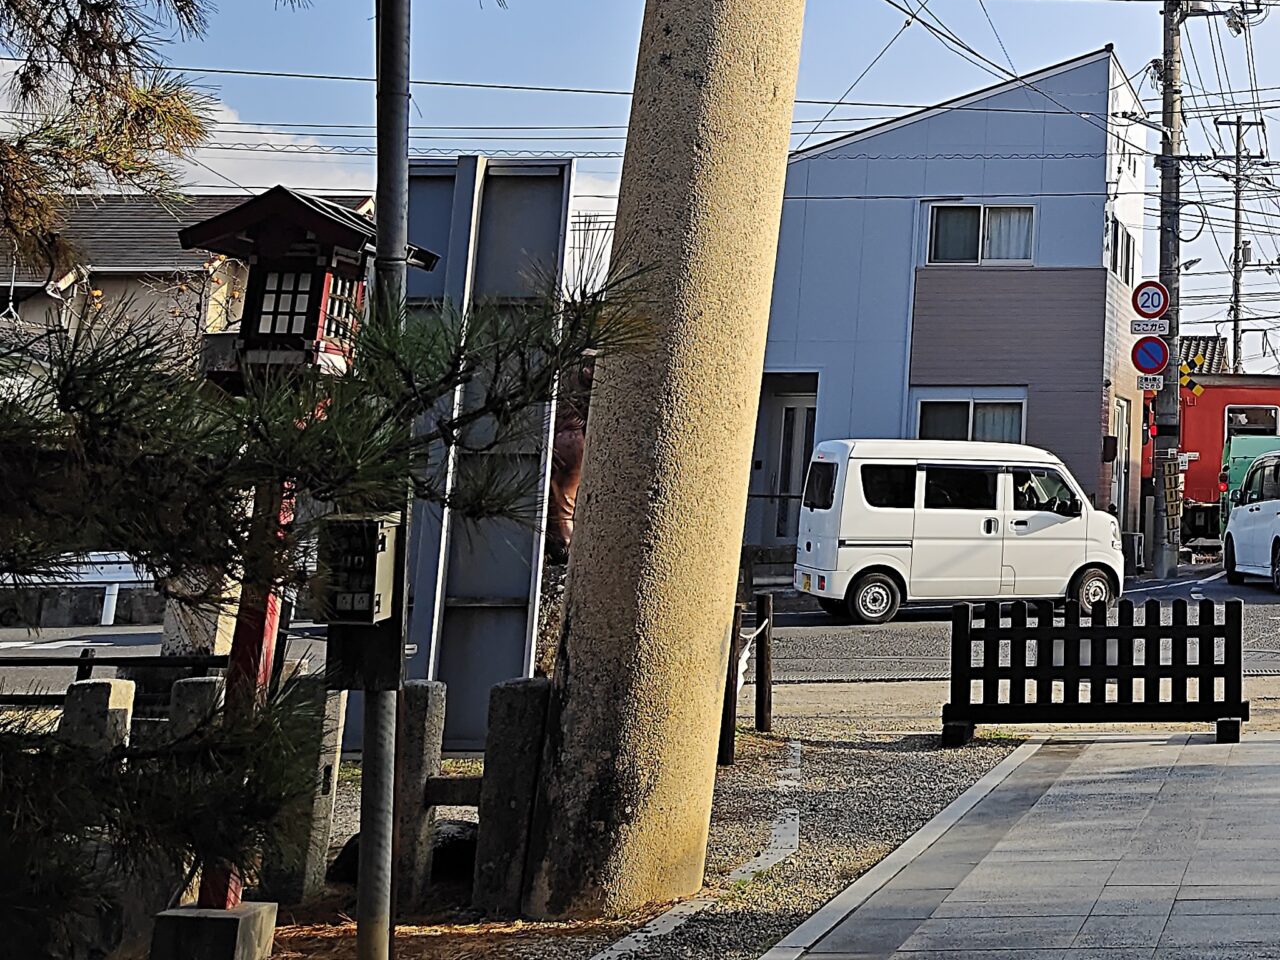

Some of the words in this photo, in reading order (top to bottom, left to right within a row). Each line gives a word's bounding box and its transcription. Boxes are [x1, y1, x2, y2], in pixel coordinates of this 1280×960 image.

[1140, 291, 1161, 308] 20
[1133, 323, 1166, 332] ここから
